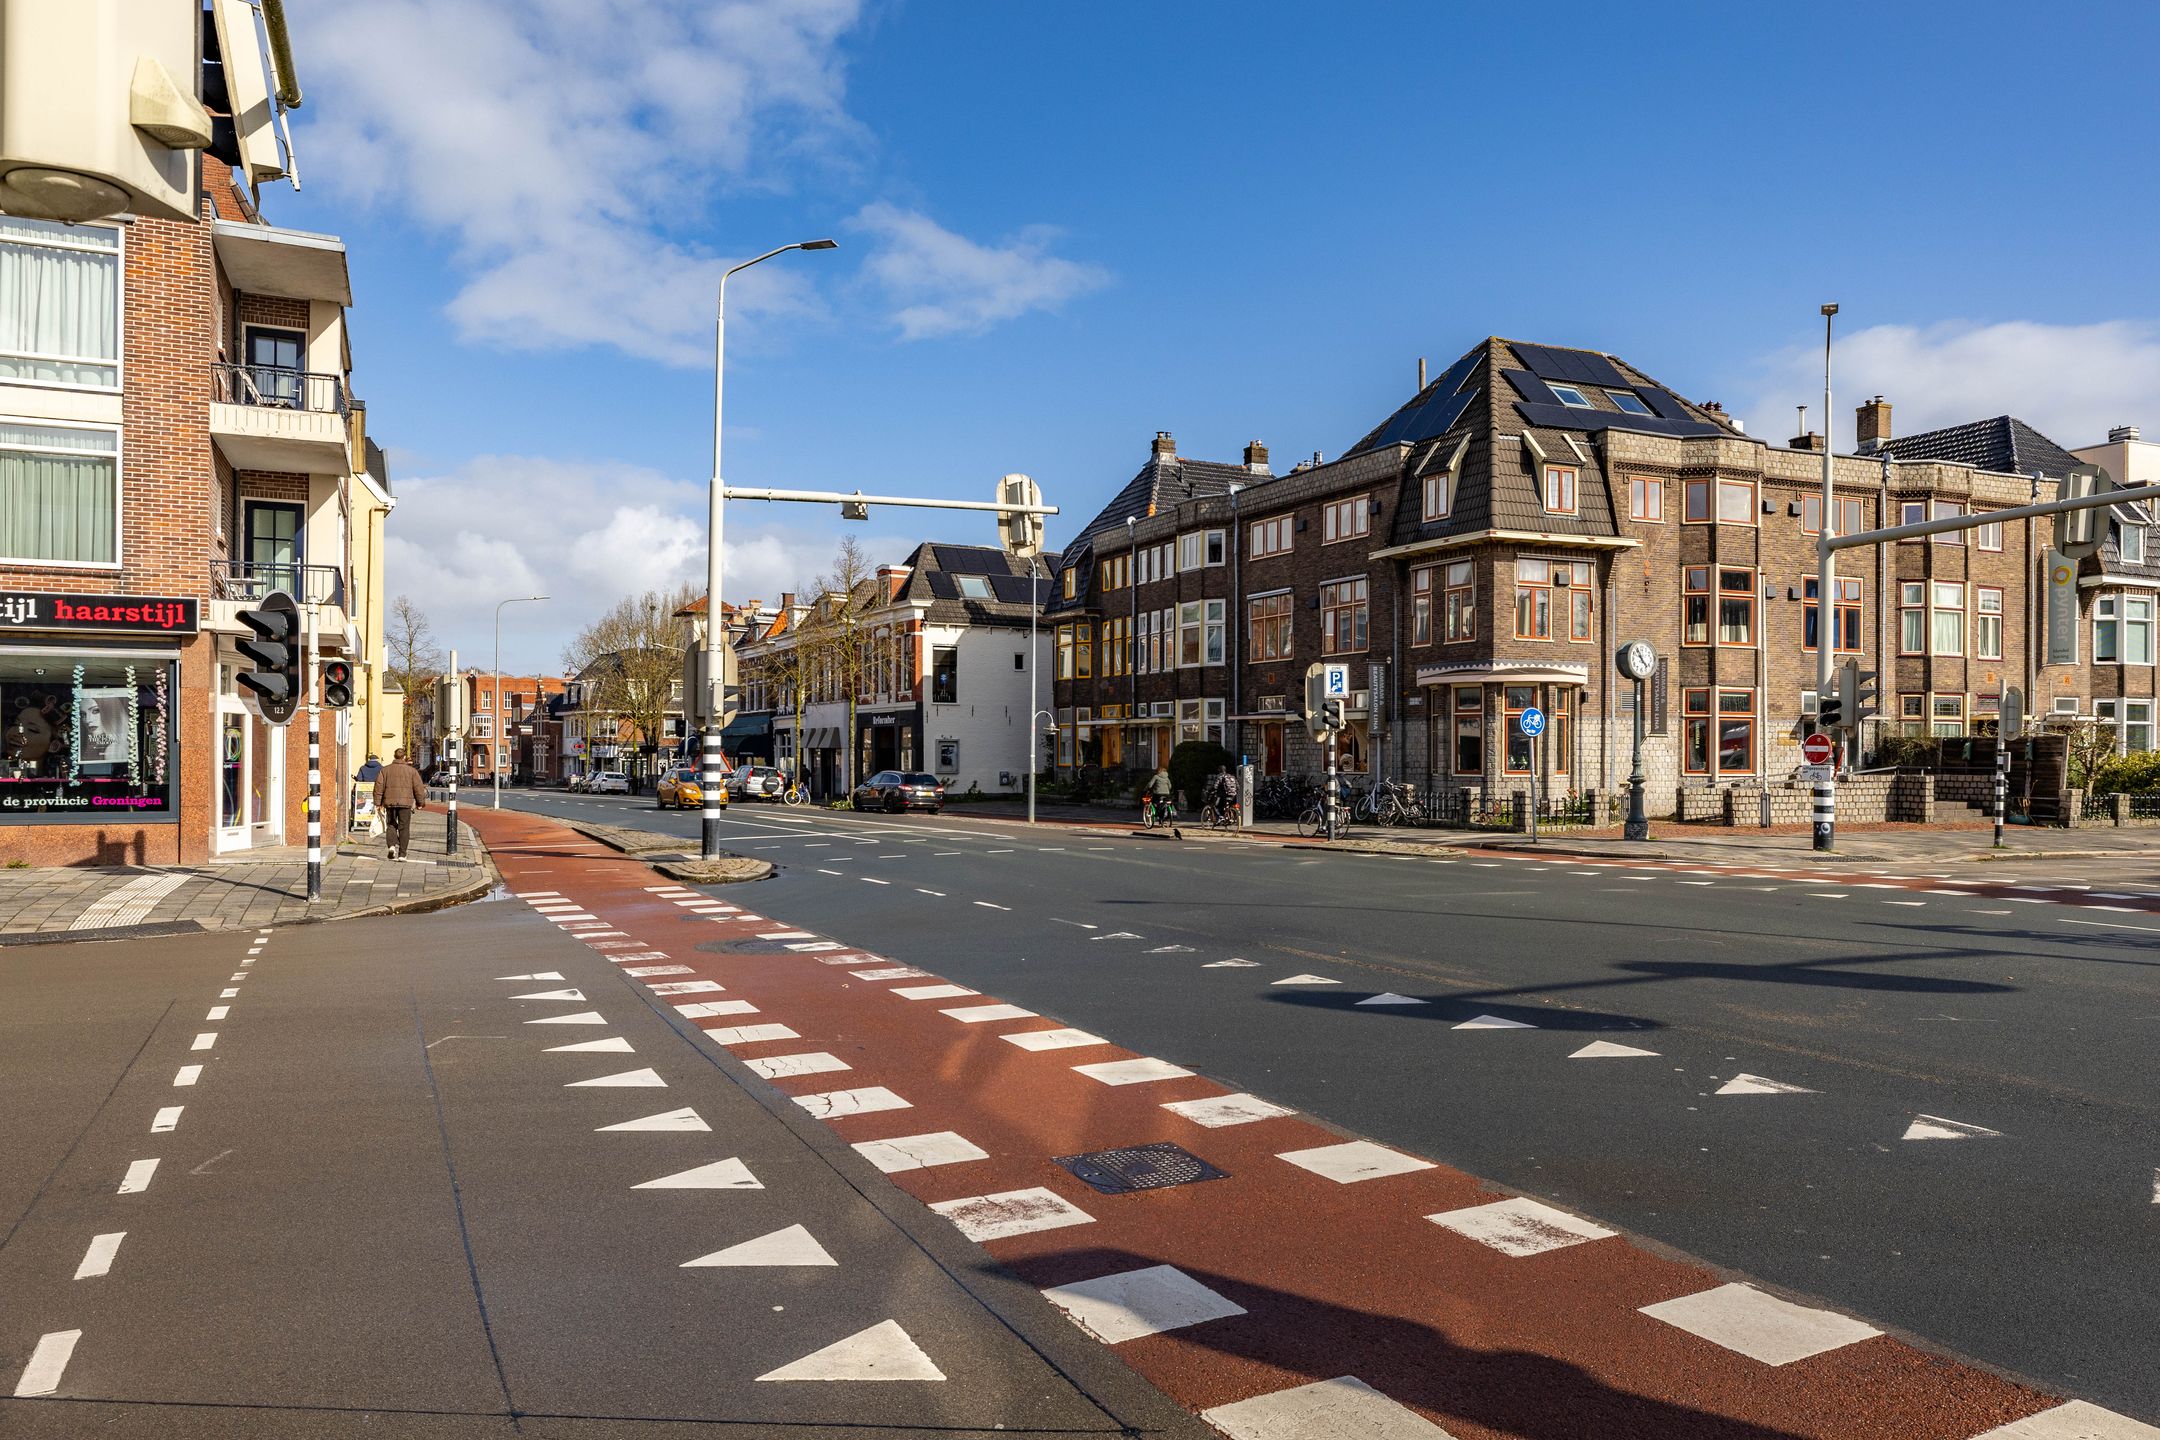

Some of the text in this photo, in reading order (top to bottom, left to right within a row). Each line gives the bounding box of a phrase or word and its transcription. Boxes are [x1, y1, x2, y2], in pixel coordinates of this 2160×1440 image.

[54, 599, 186, 628] haarstijl
[2055, 588, 2069, 640] pynter
[1333, 672, 1340, 684] P
[273, 706, 285, 715] 12.2
[3, 795, 162, 809] de provincie Groningen
